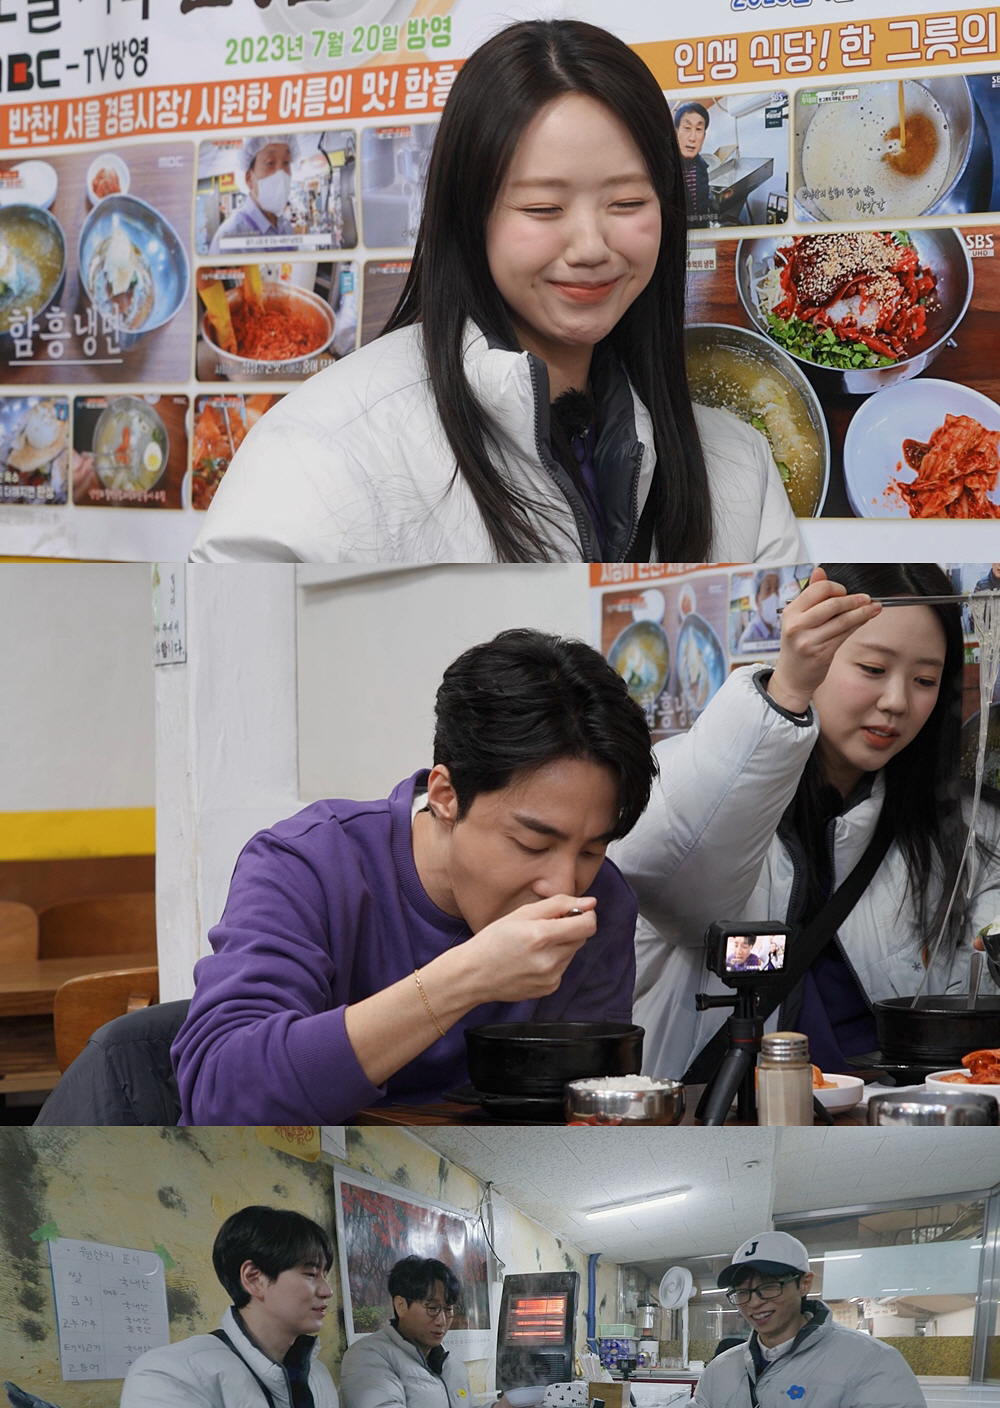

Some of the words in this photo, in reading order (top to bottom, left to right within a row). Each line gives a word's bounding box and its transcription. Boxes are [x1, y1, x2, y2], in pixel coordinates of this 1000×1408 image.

[225, 35, 304, 65] 2023년
[312, 30, 344, 59] 7월
[351, 24, 399, 54] 20일
[407, 16, 452, 50] 방영
[674, 38, 738, 84] 인생
[750, 29, 831, 75] 식당!
[839, 24, 875, 69] 한
[0, 49, 61, 92] BC
[8, 104, 60, 145] 반찬!
[63, 100, 101, 140] 서울
[104, 88, 192, 136] 경동시장!
[196, 81, 272, 126] 시원한
[278, 74, 353, 119] 여름의
[362, 71, 399, 113] 맛!
[966, 233, 994, 249] SBS
[7, 302, 123, 359] 함흥냉면
[744, 1241, 759, 1257] J
[119, 1276, 150, 1290] 국내산
[122, 1300, 149, 1312] 국내산
